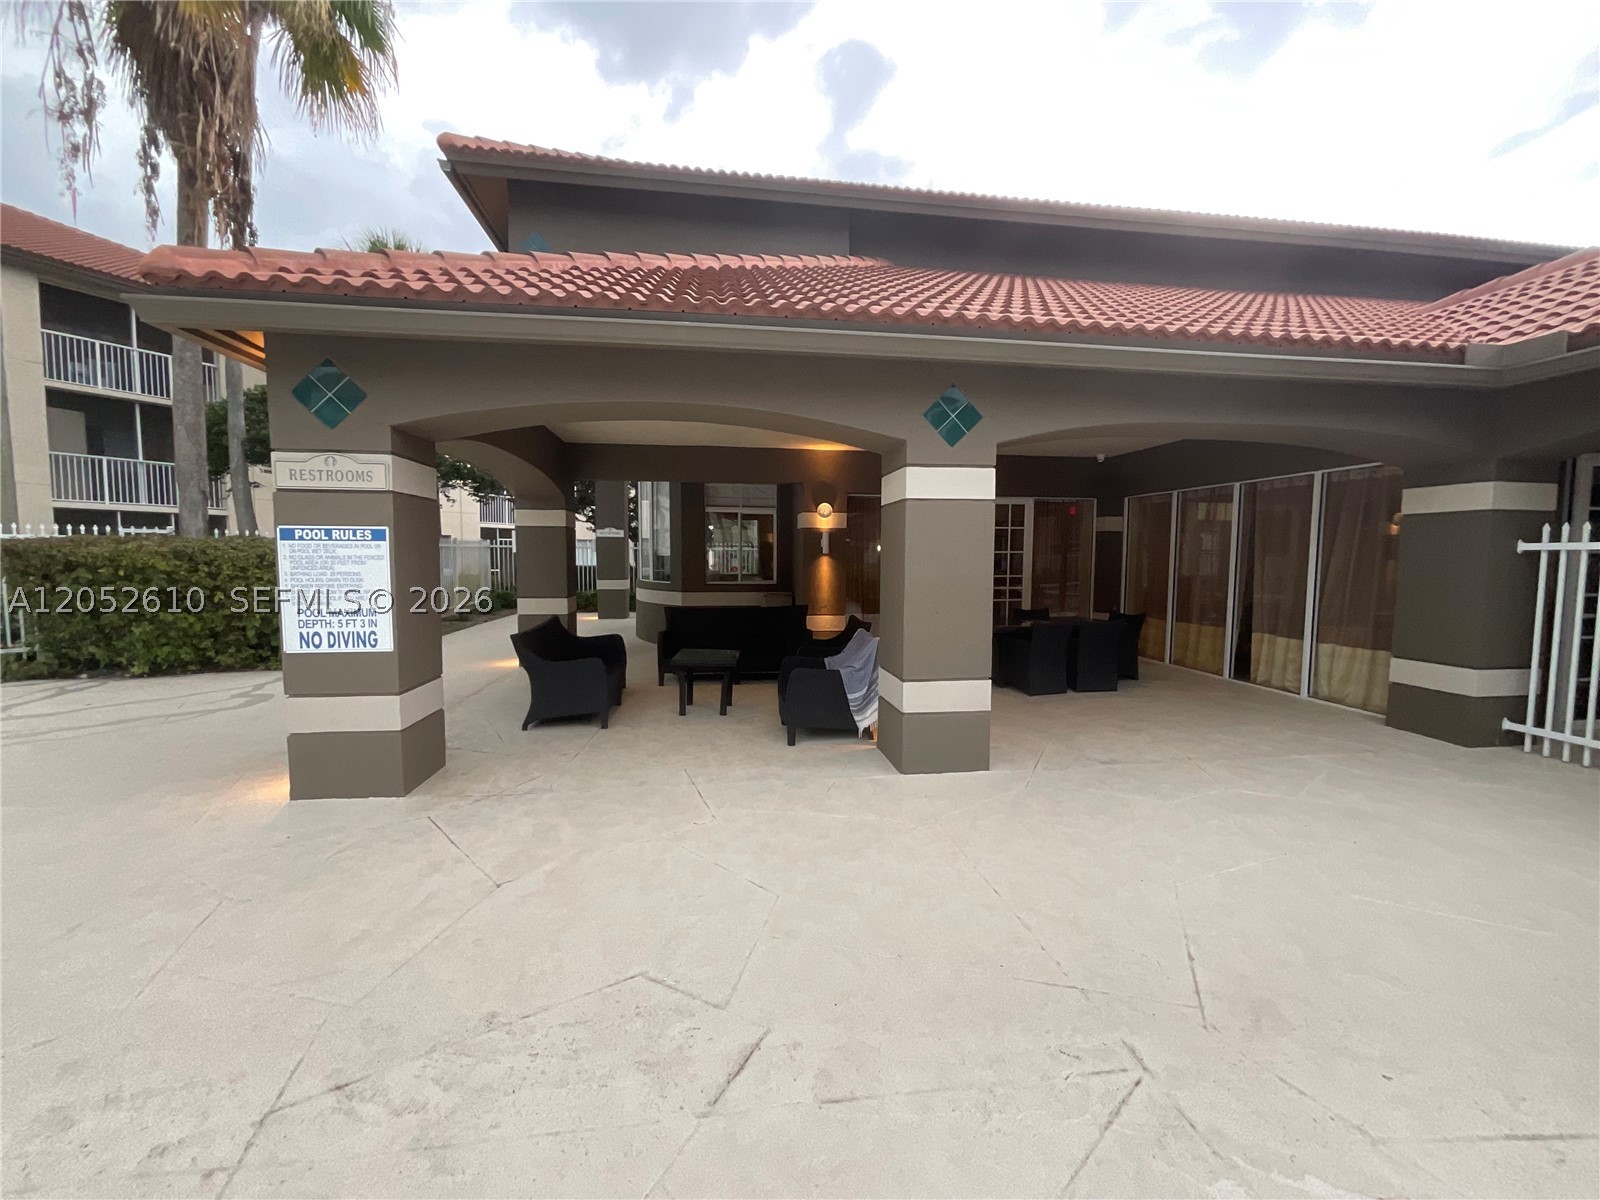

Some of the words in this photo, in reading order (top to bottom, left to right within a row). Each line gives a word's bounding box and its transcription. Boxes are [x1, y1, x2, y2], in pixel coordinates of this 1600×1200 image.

[289, 468, 374, 482] RESTROOMS
[294, 529, 328, 540] POOL
[332, 529, 372, 540] RULES
[298, 608, 326, 617] POOL
[328, 608, 376, 617] MAXIMUM
[298, 620, 335, 628] DEPTH:
[338, 620, 343, 628] 5
[346, 620, 357, 628] FT
[360, 620, 366, 628] 3
[368, 620, 378, 628] IN
[300, 631, 322, 648] NO
[327, 631, 378, 648] DIVING
